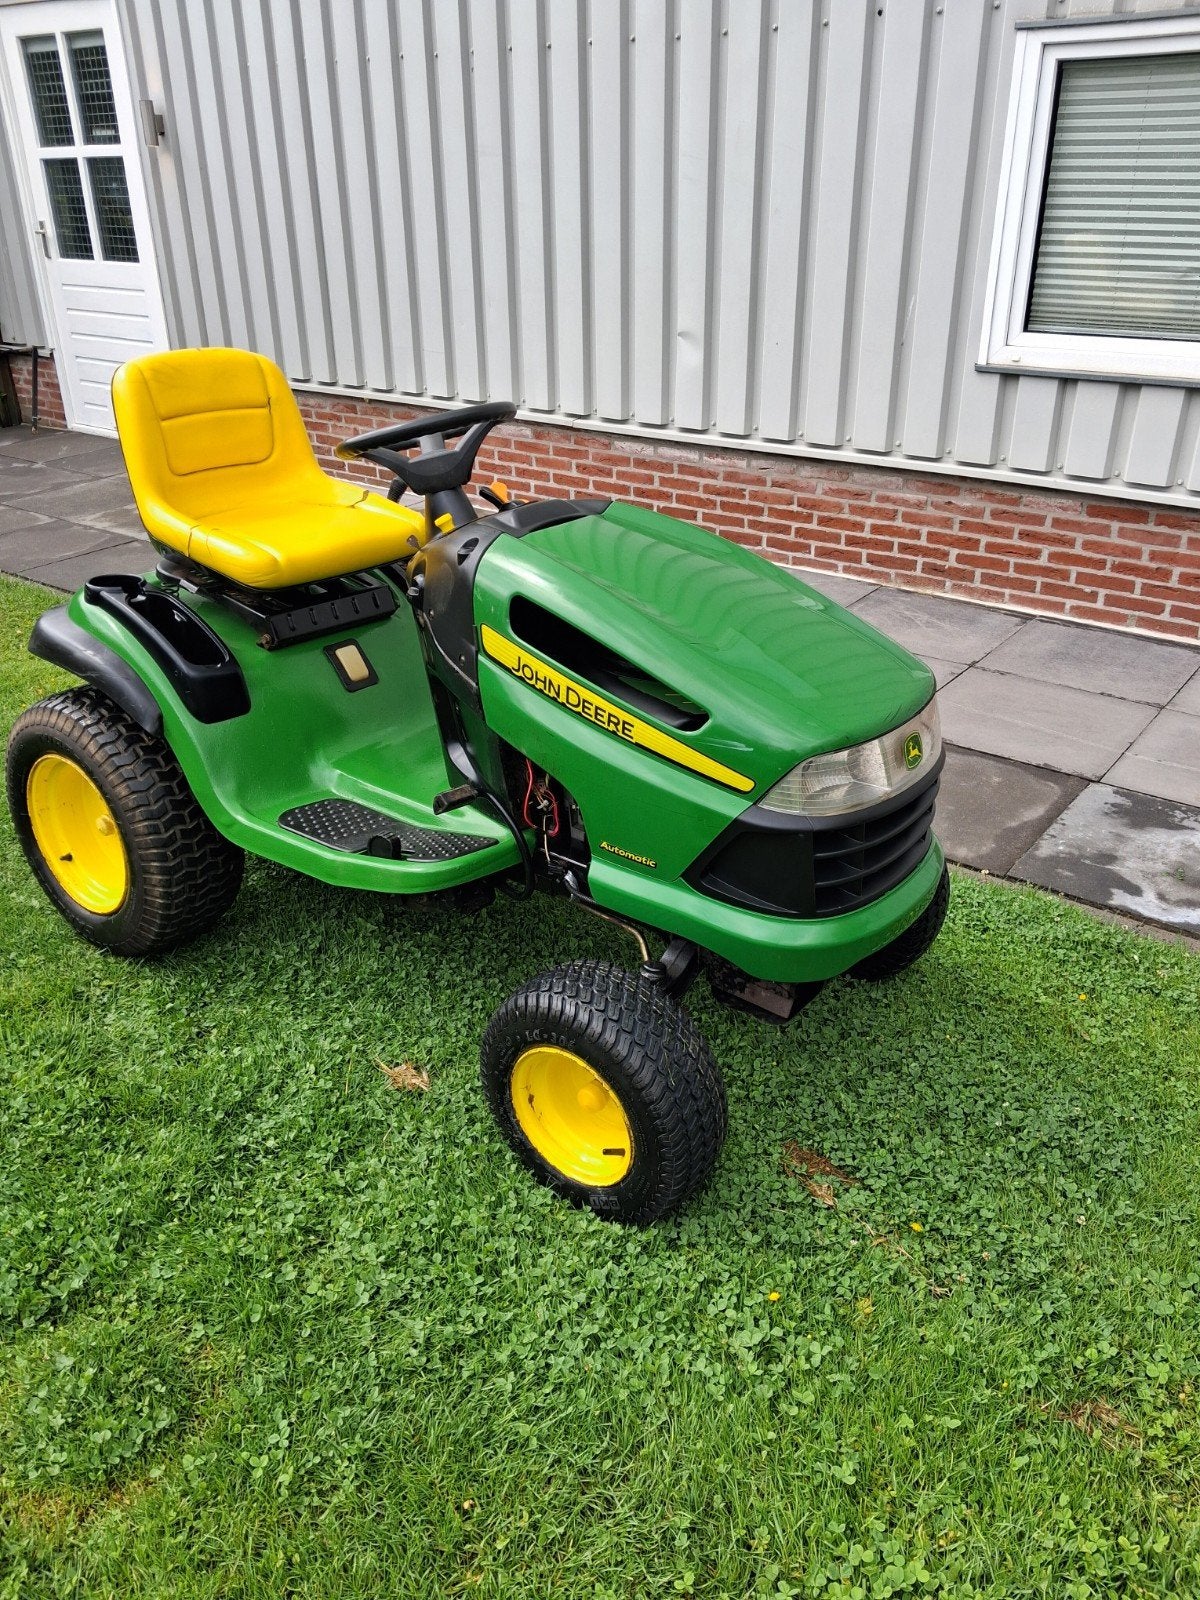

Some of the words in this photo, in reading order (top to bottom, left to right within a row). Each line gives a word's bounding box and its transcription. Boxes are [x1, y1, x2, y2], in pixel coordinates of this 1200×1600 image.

[511, 656, 561, 700] JOHN
[565, 685, 634, 740] DEERE
[600, 841, 656, 868] Automatic
